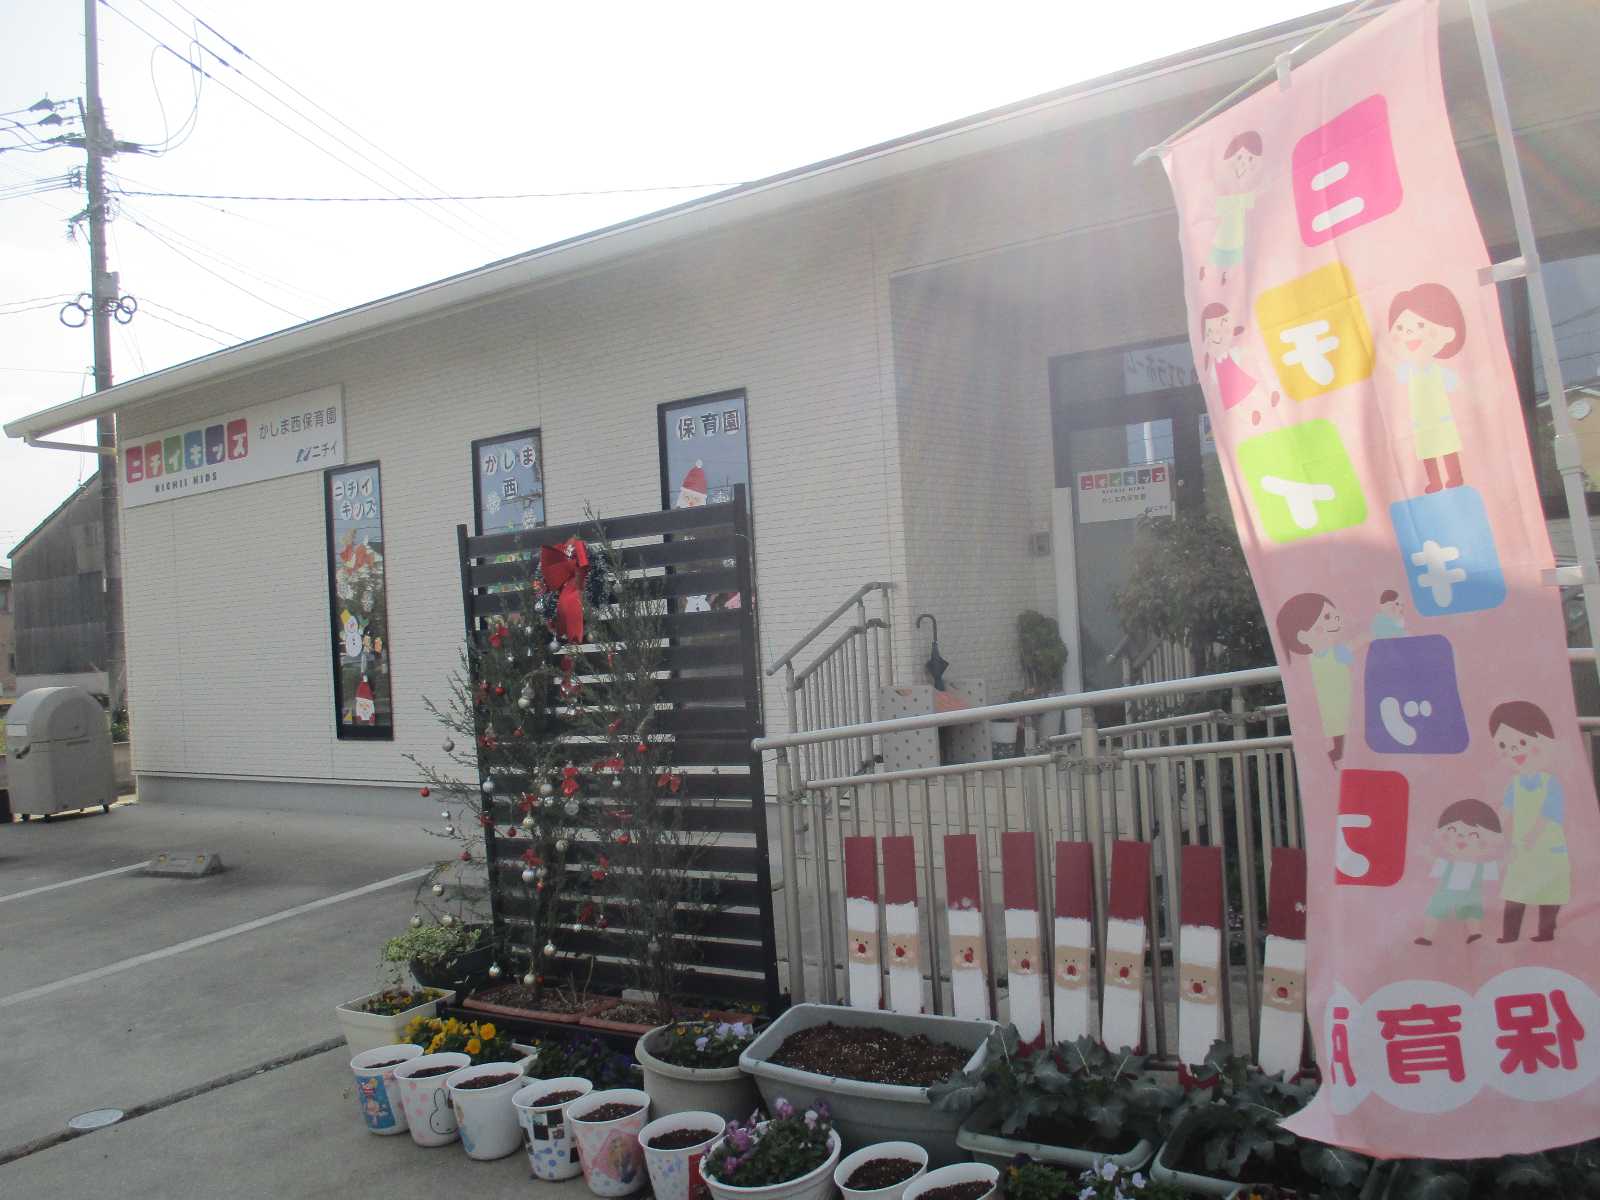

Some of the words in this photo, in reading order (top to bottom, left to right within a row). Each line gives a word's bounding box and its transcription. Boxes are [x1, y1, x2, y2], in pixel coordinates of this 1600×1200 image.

[258, 407, 336, 440] かしま西保育園
[678, 410, 739, 440] 保育園
[131, 432, 247, 479] ニチイキッズ
[485, 447, 533, 473] かしま
[503, 479, 518, 498] 西
